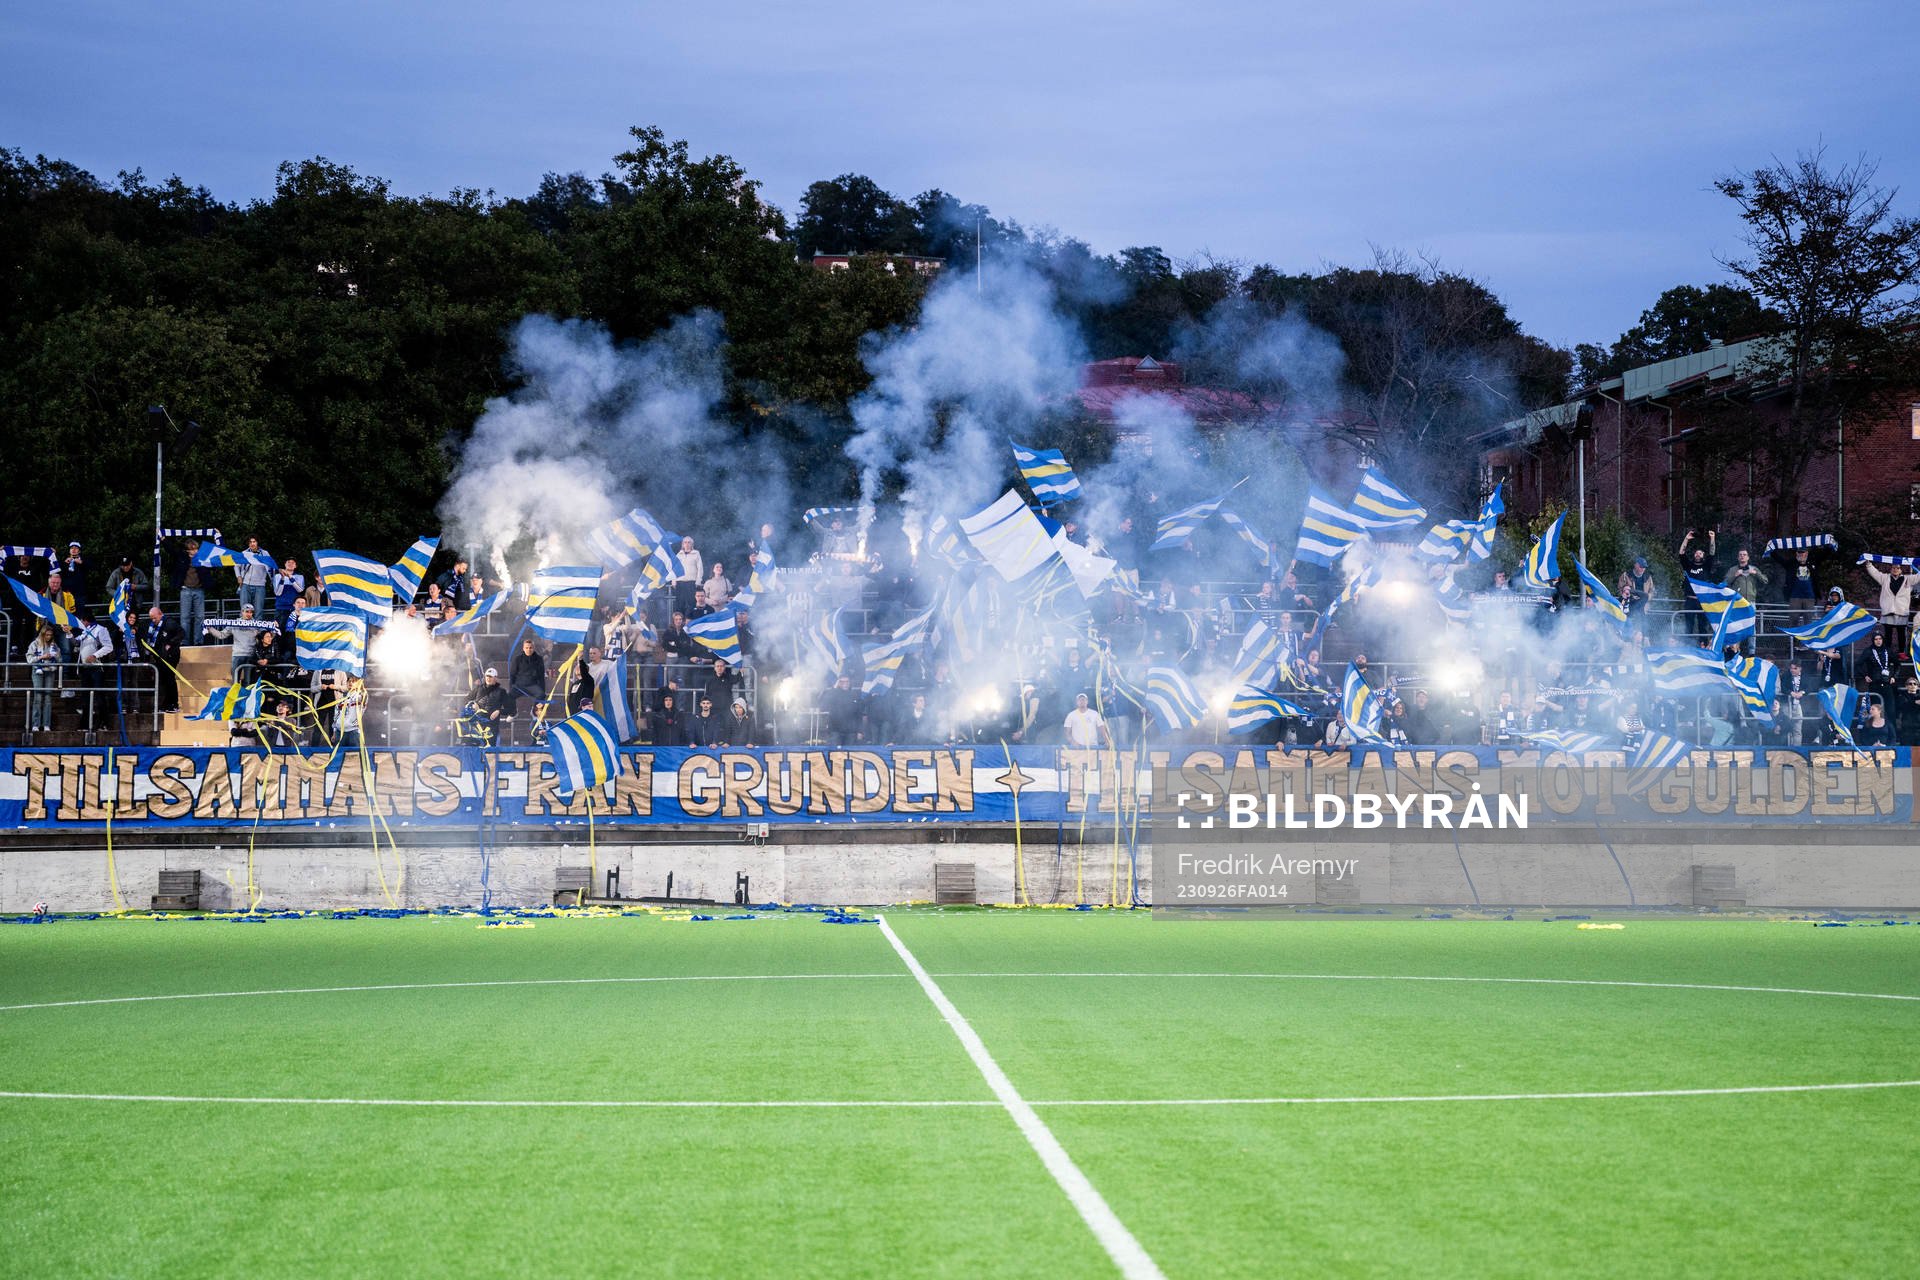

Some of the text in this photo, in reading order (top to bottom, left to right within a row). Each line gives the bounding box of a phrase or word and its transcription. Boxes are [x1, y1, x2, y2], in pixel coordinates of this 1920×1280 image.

[13, 752, 464, 820] TILLSAMMANS
[677, 749, 977, 817] GRUNDEN
[1057, 748, 1481, 815] TILLSAMMANS
[1497, 749, 1627, 815] MOT
[1648, 748, 1898, 815] GULDEN
